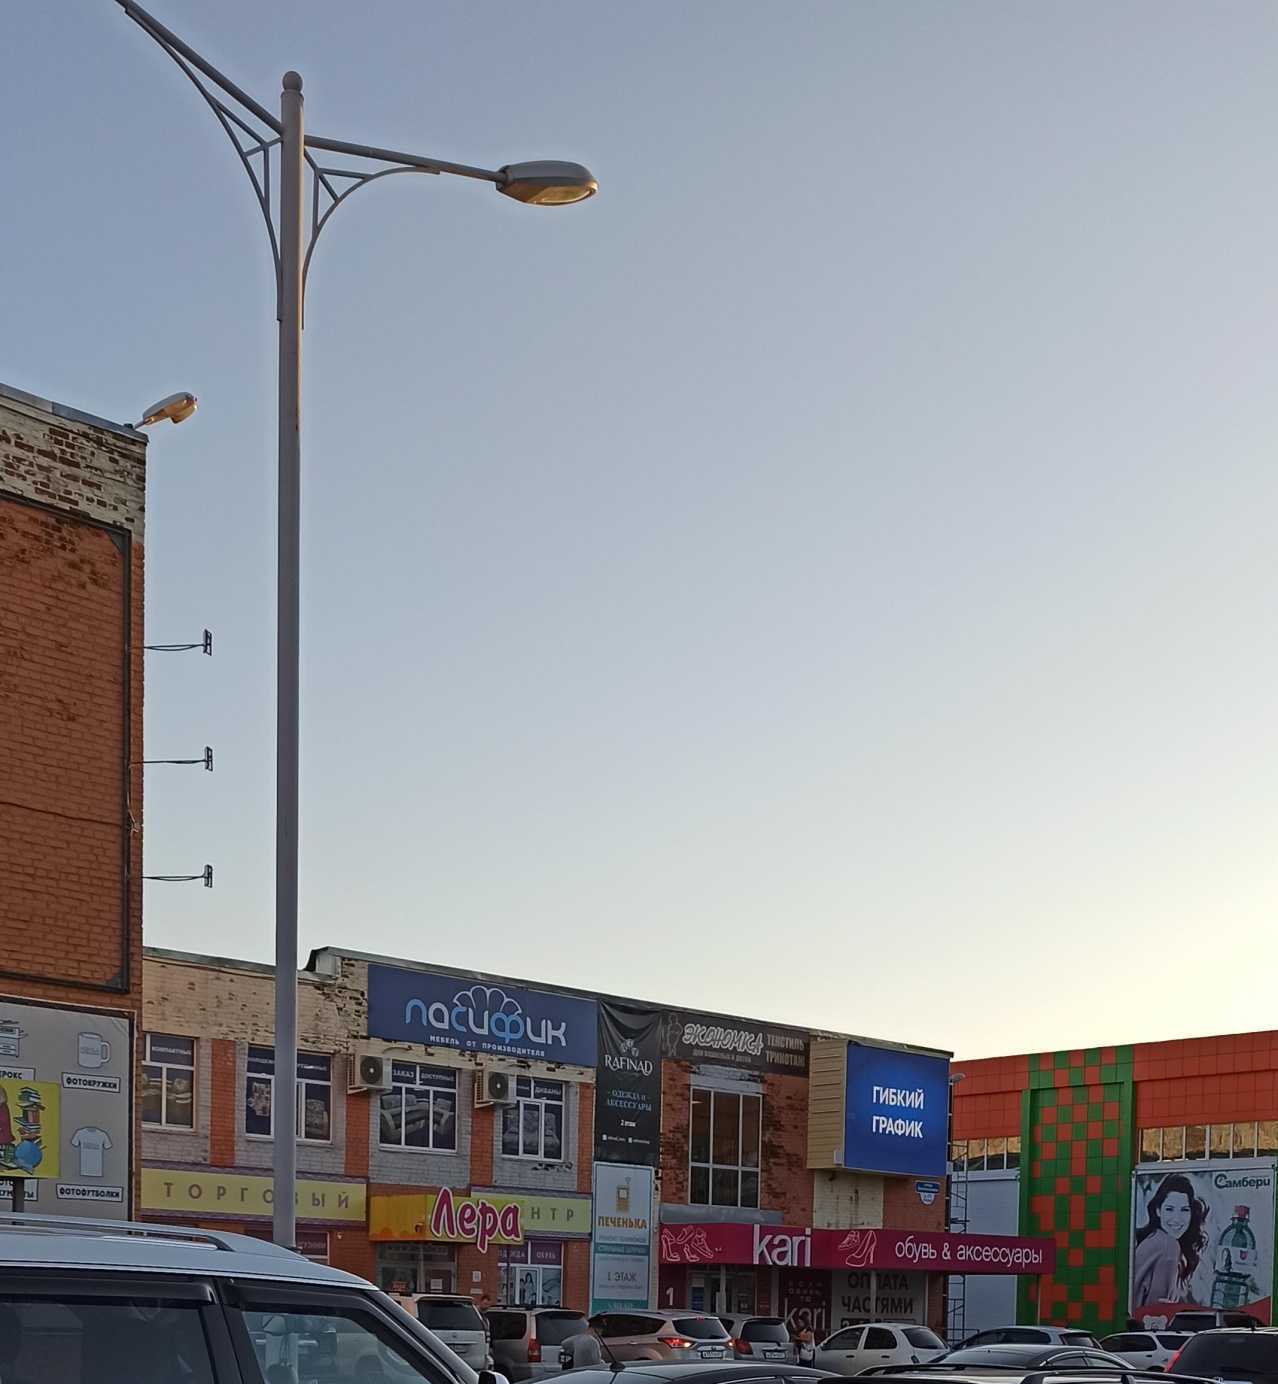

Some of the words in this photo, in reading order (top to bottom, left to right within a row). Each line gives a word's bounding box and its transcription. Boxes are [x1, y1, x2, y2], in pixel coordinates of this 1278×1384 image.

[430, 1034, 460, 1045] МЕБЕЛЬ
[466, 1040, 477, 1048] ОТ
[482, 1042, 545, 1057] ПРОИЗВОДИТЕЛЯ
[604, 1053, 653, 1077] RAFINAD
[65, 1076, 118, 1090] ФОТОКРУЖКИ
[872, 1086, 924, 1110] ГИБКИЙ
[872, 1115, 924, 1139] ГРАФИК
[59, 1186, 121, 1199] ФОТОФУТБОЛКИ
[1214, 1173, 1271, 1190] Самбери
[163, 1182, 350, 1208] ТОРГОЫЙ
[531, 1206, 575, 1222] НТР
[431, 1186, 523, 1254] Лера
[597, 1216, 648, 1230] ПЕЧЕНЬКА
[753, 1223, 812, 1268] kari
[895, 1234, 937, 1264] обувь
[956, 1243, 1042, 1268] аксессуары
[665, 1287, 674, 1306] 1
